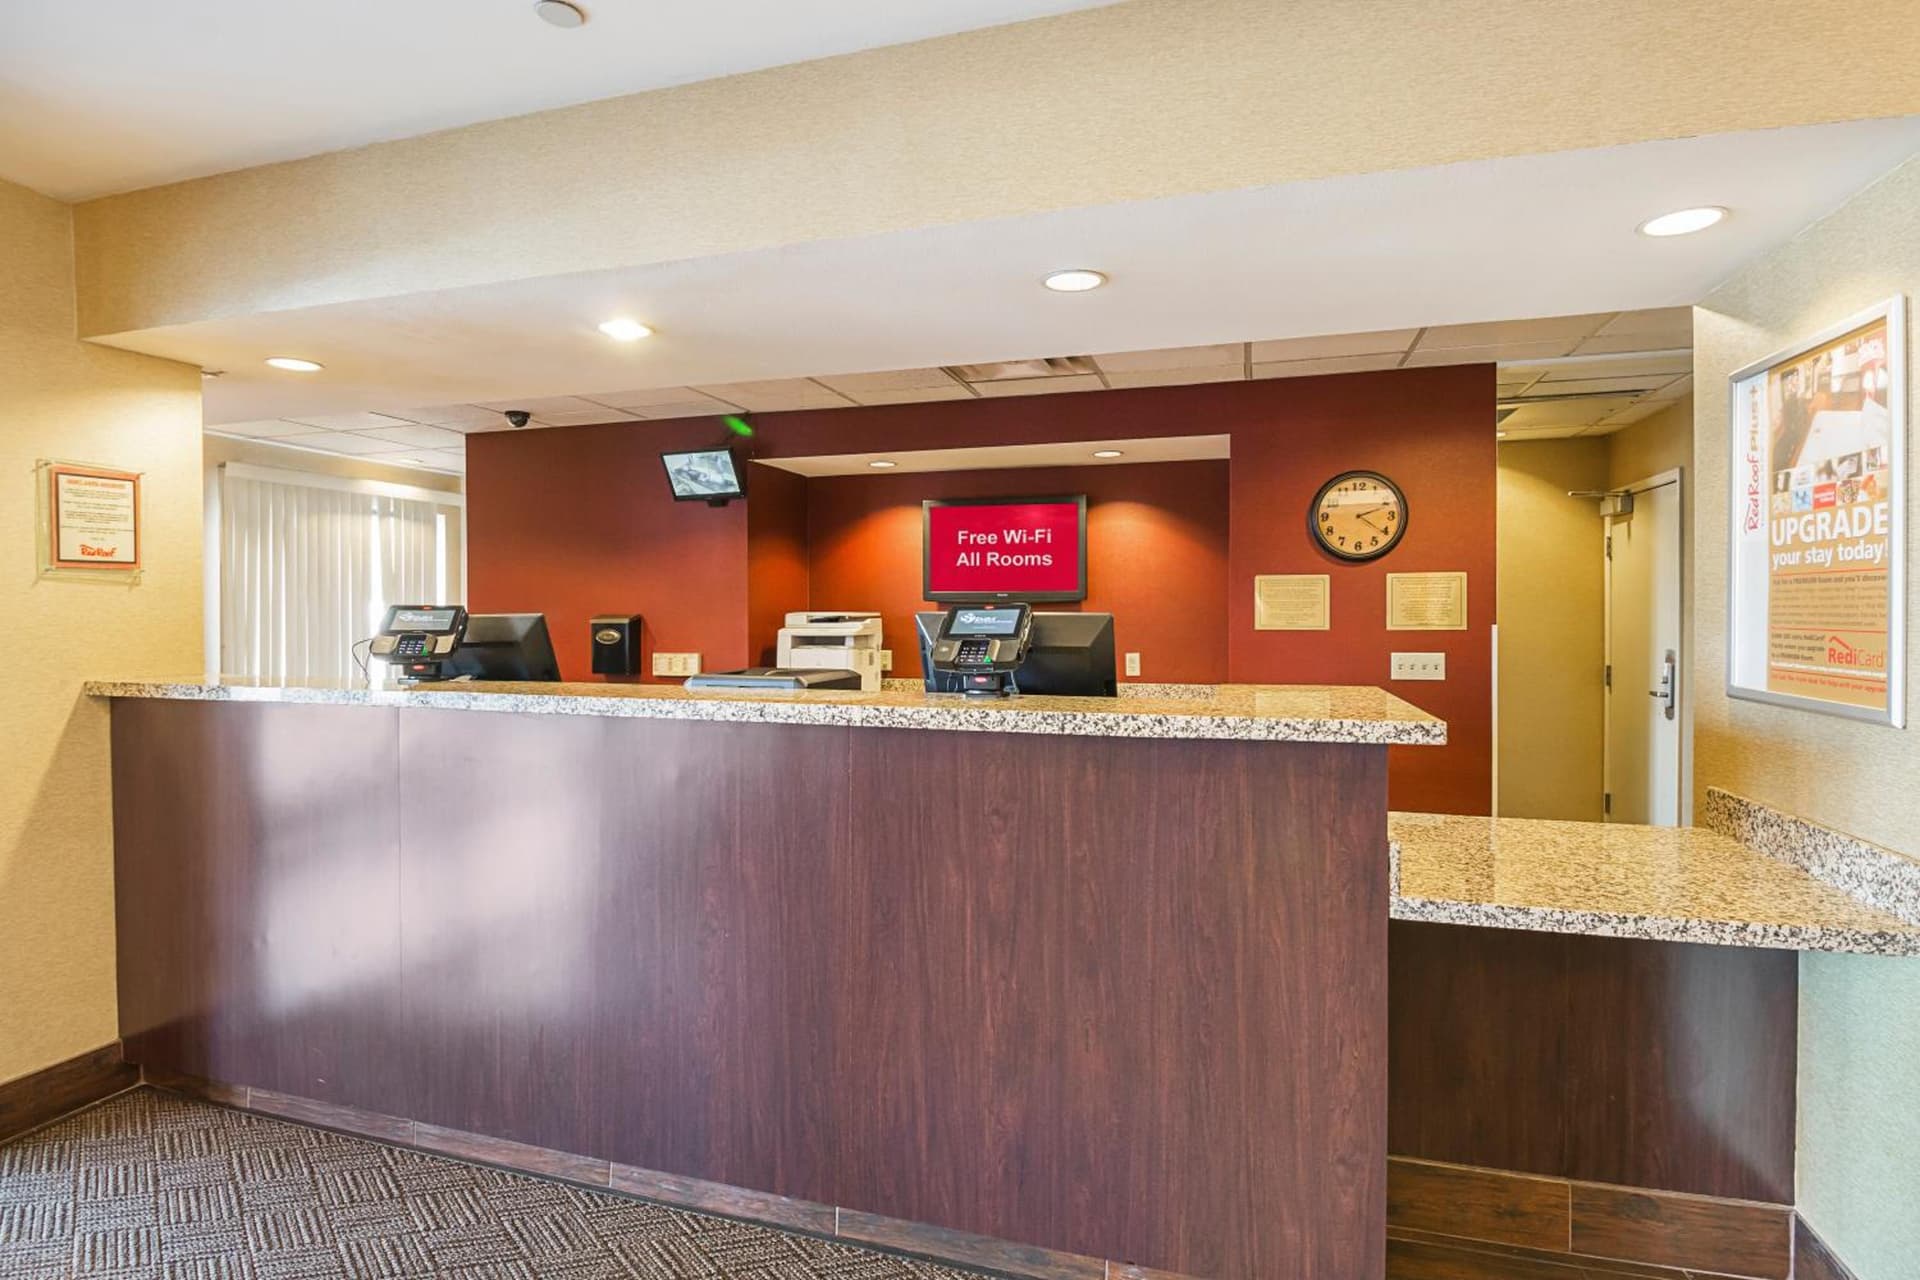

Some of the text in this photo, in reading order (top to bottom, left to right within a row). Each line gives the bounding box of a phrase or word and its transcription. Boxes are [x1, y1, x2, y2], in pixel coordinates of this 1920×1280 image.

[1352, 482, 1367, 491] 12
[1321, 512, 1329, 522] 9
[1387, 511, 1395, 521] 3
[1772, 502, 1888, 547] UPGRADE
[1326, 526, 1334, 536] 8
[1381, 526, 1388, 535] 4
[957, 528, 1052, 545] Free Wi-Fi
[1338, 536, 1345, 546] 7
[1370, 536, 1378, 546] 5
[1354, 541, 1362, 551] 6
[956, 551, 1053, 567] All Rooms
[1772, 538, 1889, 571] your stay today!
[1827, 647, 1884, 668] RediCard
